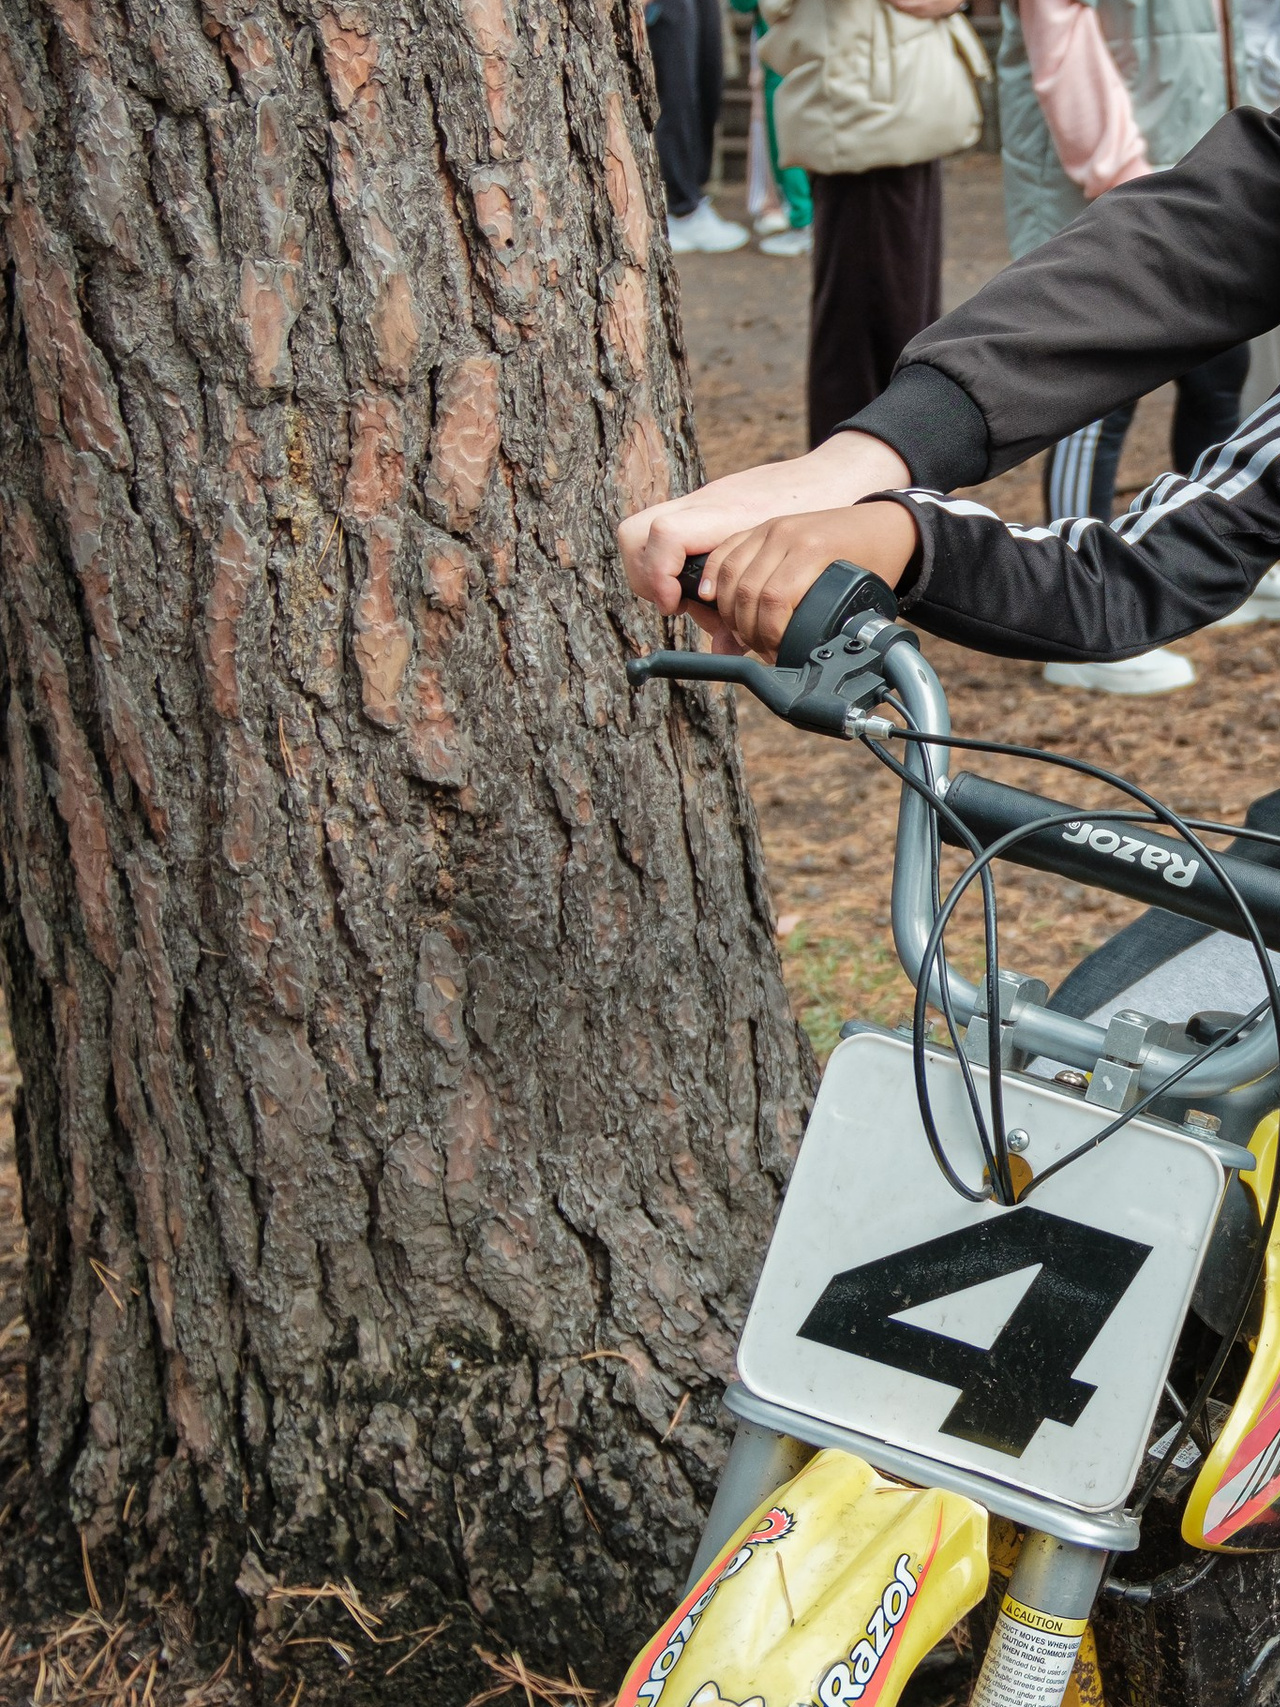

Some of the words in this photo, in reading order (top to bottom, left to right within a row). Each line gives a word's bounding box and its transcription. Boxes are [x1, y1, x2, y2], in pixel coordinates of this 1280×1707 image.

[1062, 823, 1200, 888] Razor
[795, 1205, 1154, 1459] 4
[818, 1553, 918, 1707] Razor
[1013, 1607, 1063, 1632] CAUTION
[1001, 1632, 1028, 1650] CAUTION
[1030, 1644, 1036, 1652] &
[1037, 1646, 1067, 1658] COMMON
[1001, 1642, 1020, 1657] WHEN
[1019, 1630, 1046, 1645] MOVES
[1047, 1640, 1068, 1650] WHEN
[1037, 1665, 1046, 1674] be
